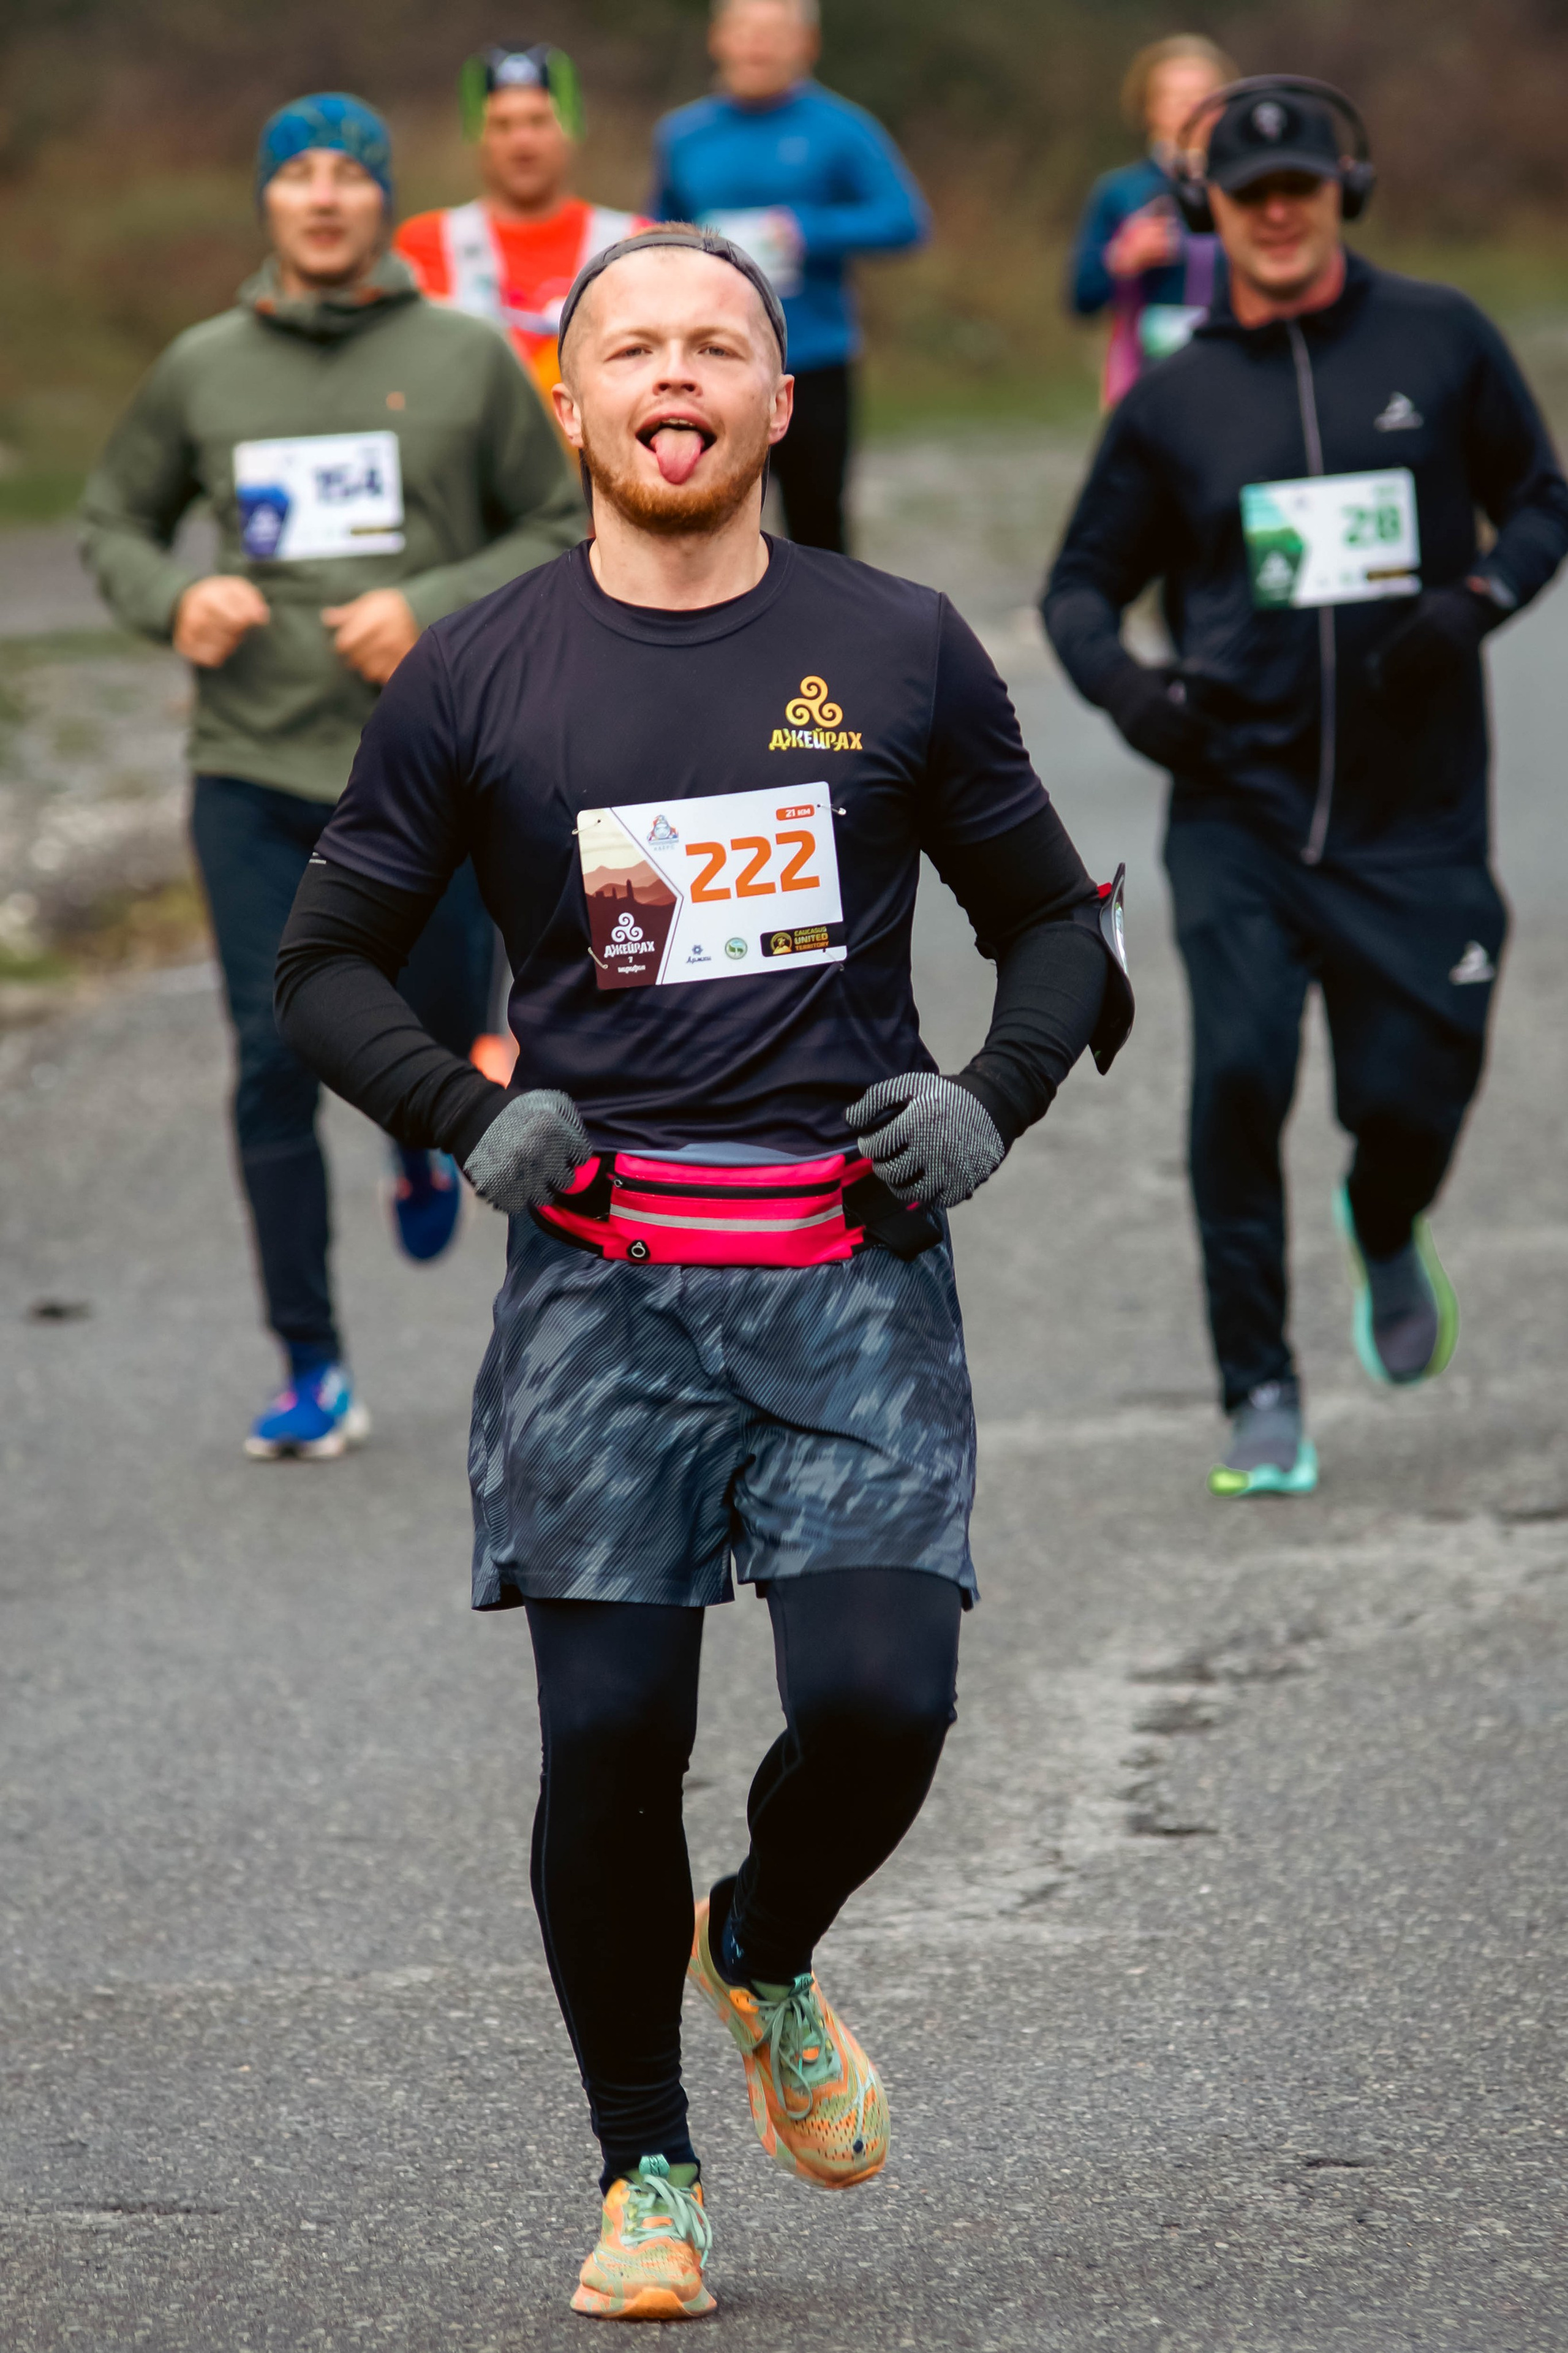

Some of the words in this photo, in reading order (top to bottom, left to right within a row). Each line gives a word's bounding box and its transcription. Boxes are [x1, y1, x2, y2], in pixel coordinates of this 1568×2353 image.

[769, 728, 862, 751] ДЖЕЙРАХ
[785, 809, 796, 818] 21
[685, 830, 820, 903] 222
[794, 926, 827, 936] CAUCASUS
[794, 933, 828, 945] UNITED
[604, 941, 655, 958] ДЖЕЙРАХ
[796, 941, 829, 951] TERRITORY
